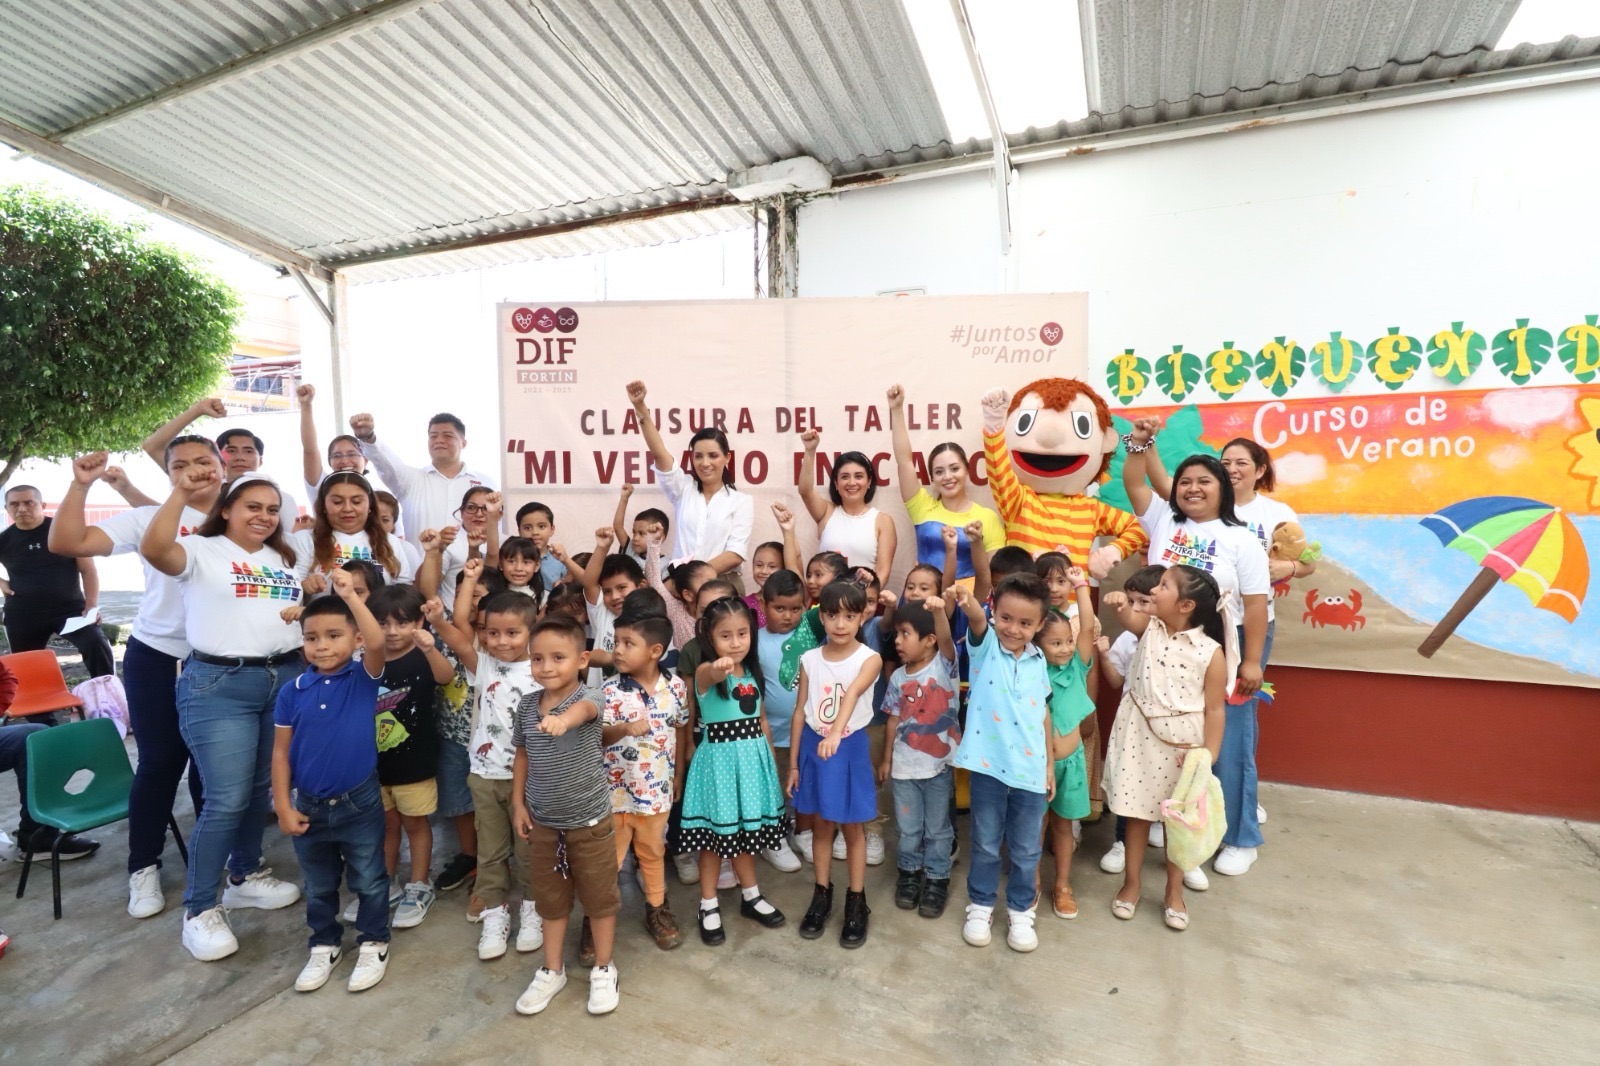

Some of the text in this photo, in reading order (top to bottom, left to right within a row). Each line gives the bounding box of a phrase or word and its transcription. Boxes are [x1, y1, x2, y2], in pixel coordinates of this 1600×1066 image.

[950, 324, 1037, 348] #Juntos
[515, 338, 577, 365] DIF
[972, 345, 1057, 364] por Amor
[521, 371, 574, 382] FORTÍN
[776, 406, 823, 434] DEL
[845, 403, 962, 432] TALER
[1252, 396, 1448, 449] Curso de
